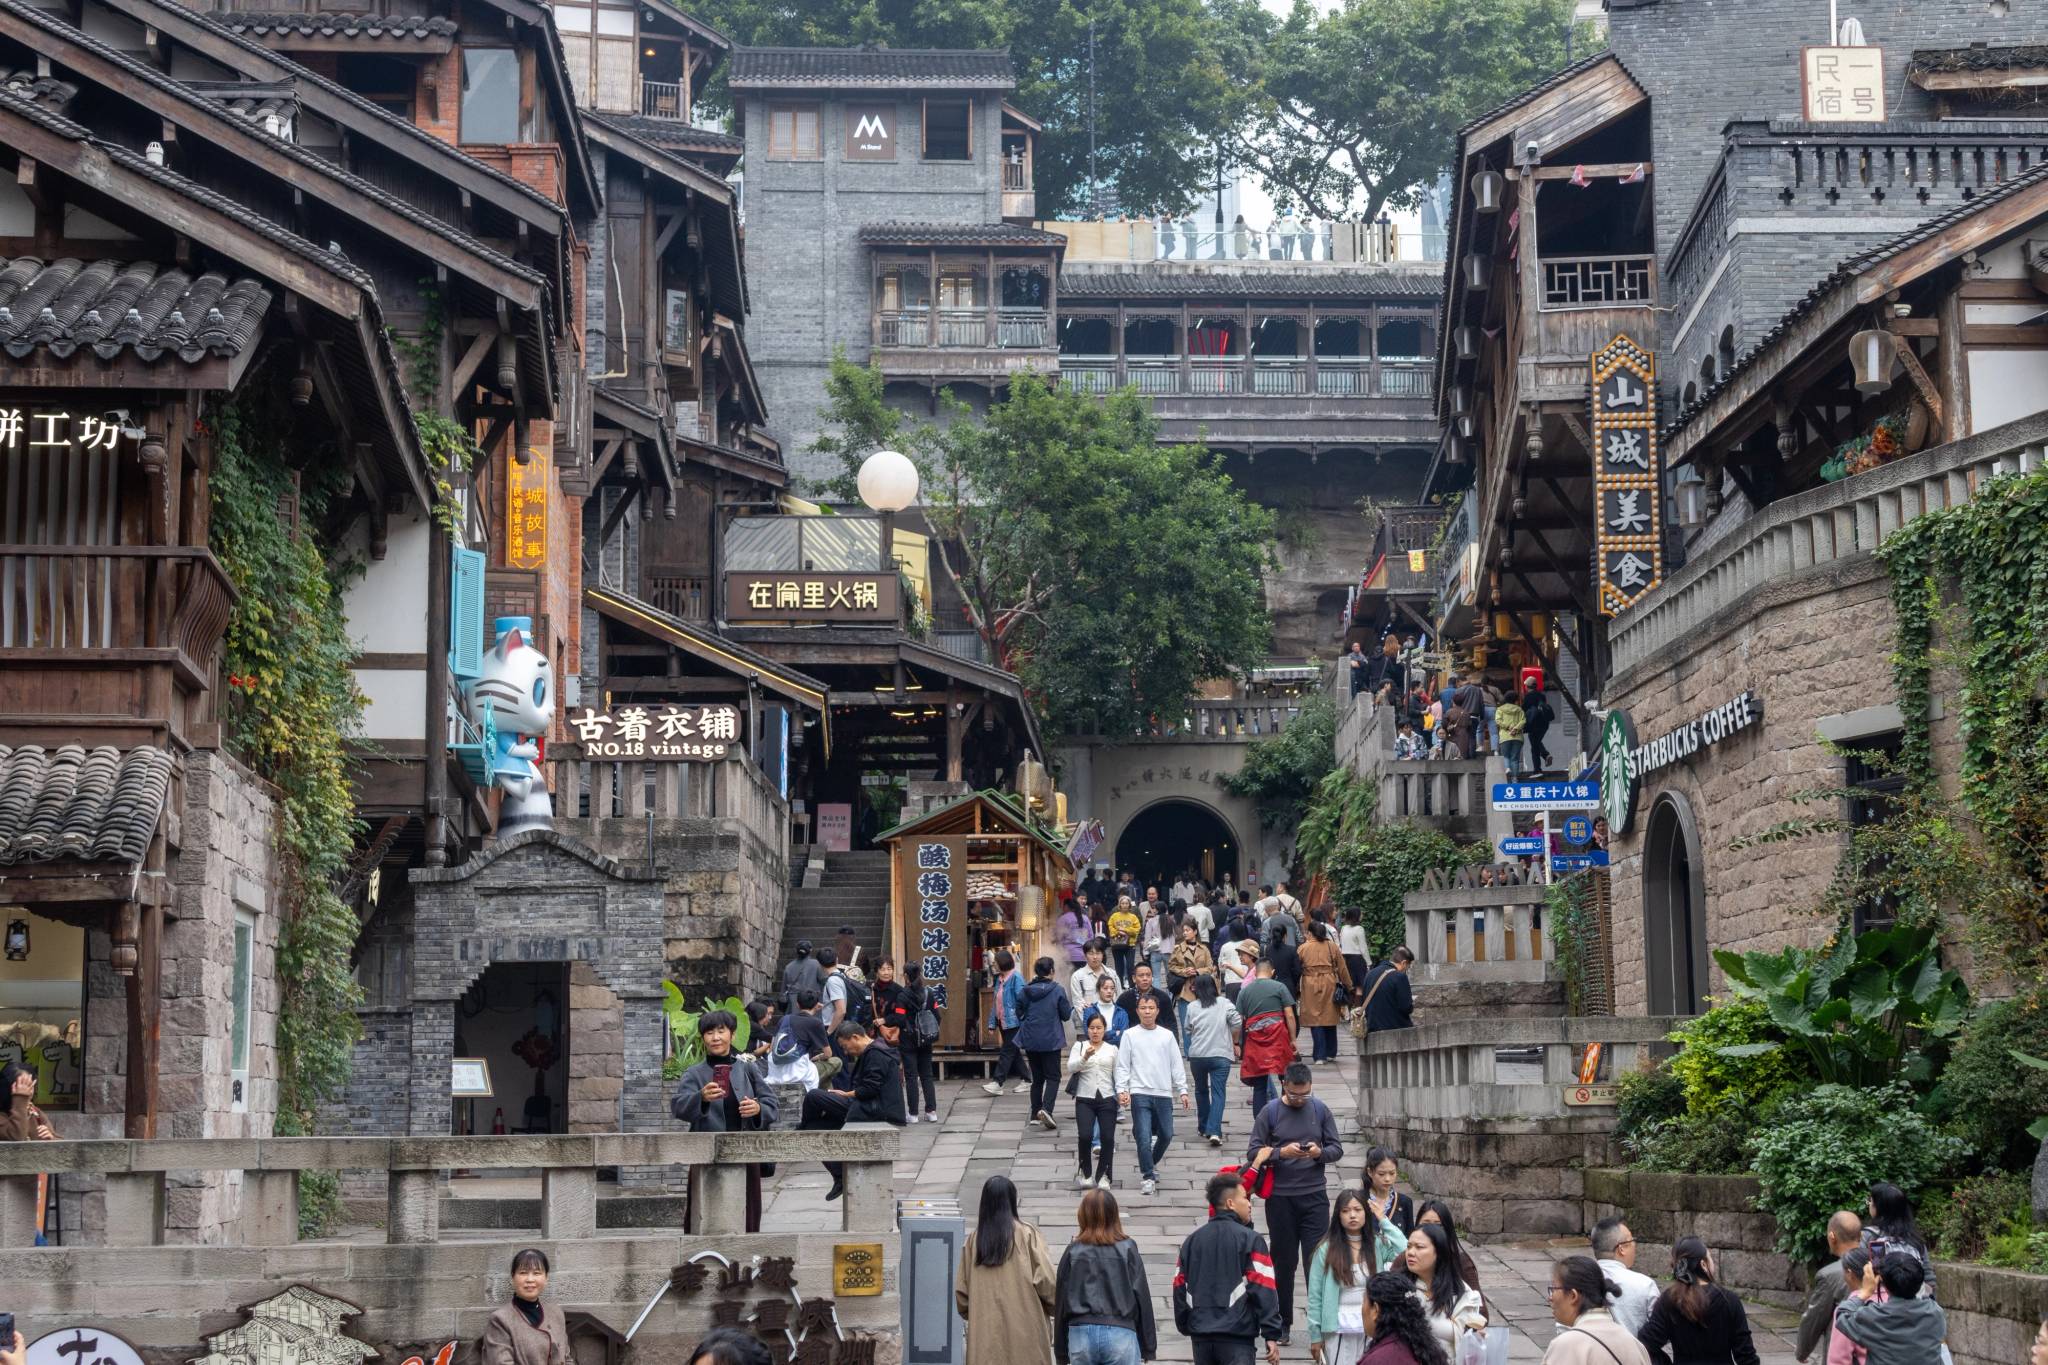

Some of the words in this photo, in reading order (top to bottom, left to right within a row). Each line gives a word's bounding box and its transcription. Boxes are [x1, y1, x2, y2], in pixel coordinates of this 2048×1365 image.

[526, 459, 544, 558] 小城故事
[1606, 376, 1653, 589] 山城美食
[570, 706, 736, 741] 古着衣铺
[587, 742, 645, 756] NO.18
[650, 740, 725, 758] vintage
[1629, 720, 1698, 779] STARBUCKS
[1702, 692, 1752, 746] COFFEE
[1520, 784, 1589, 799] 重庆十八梯
